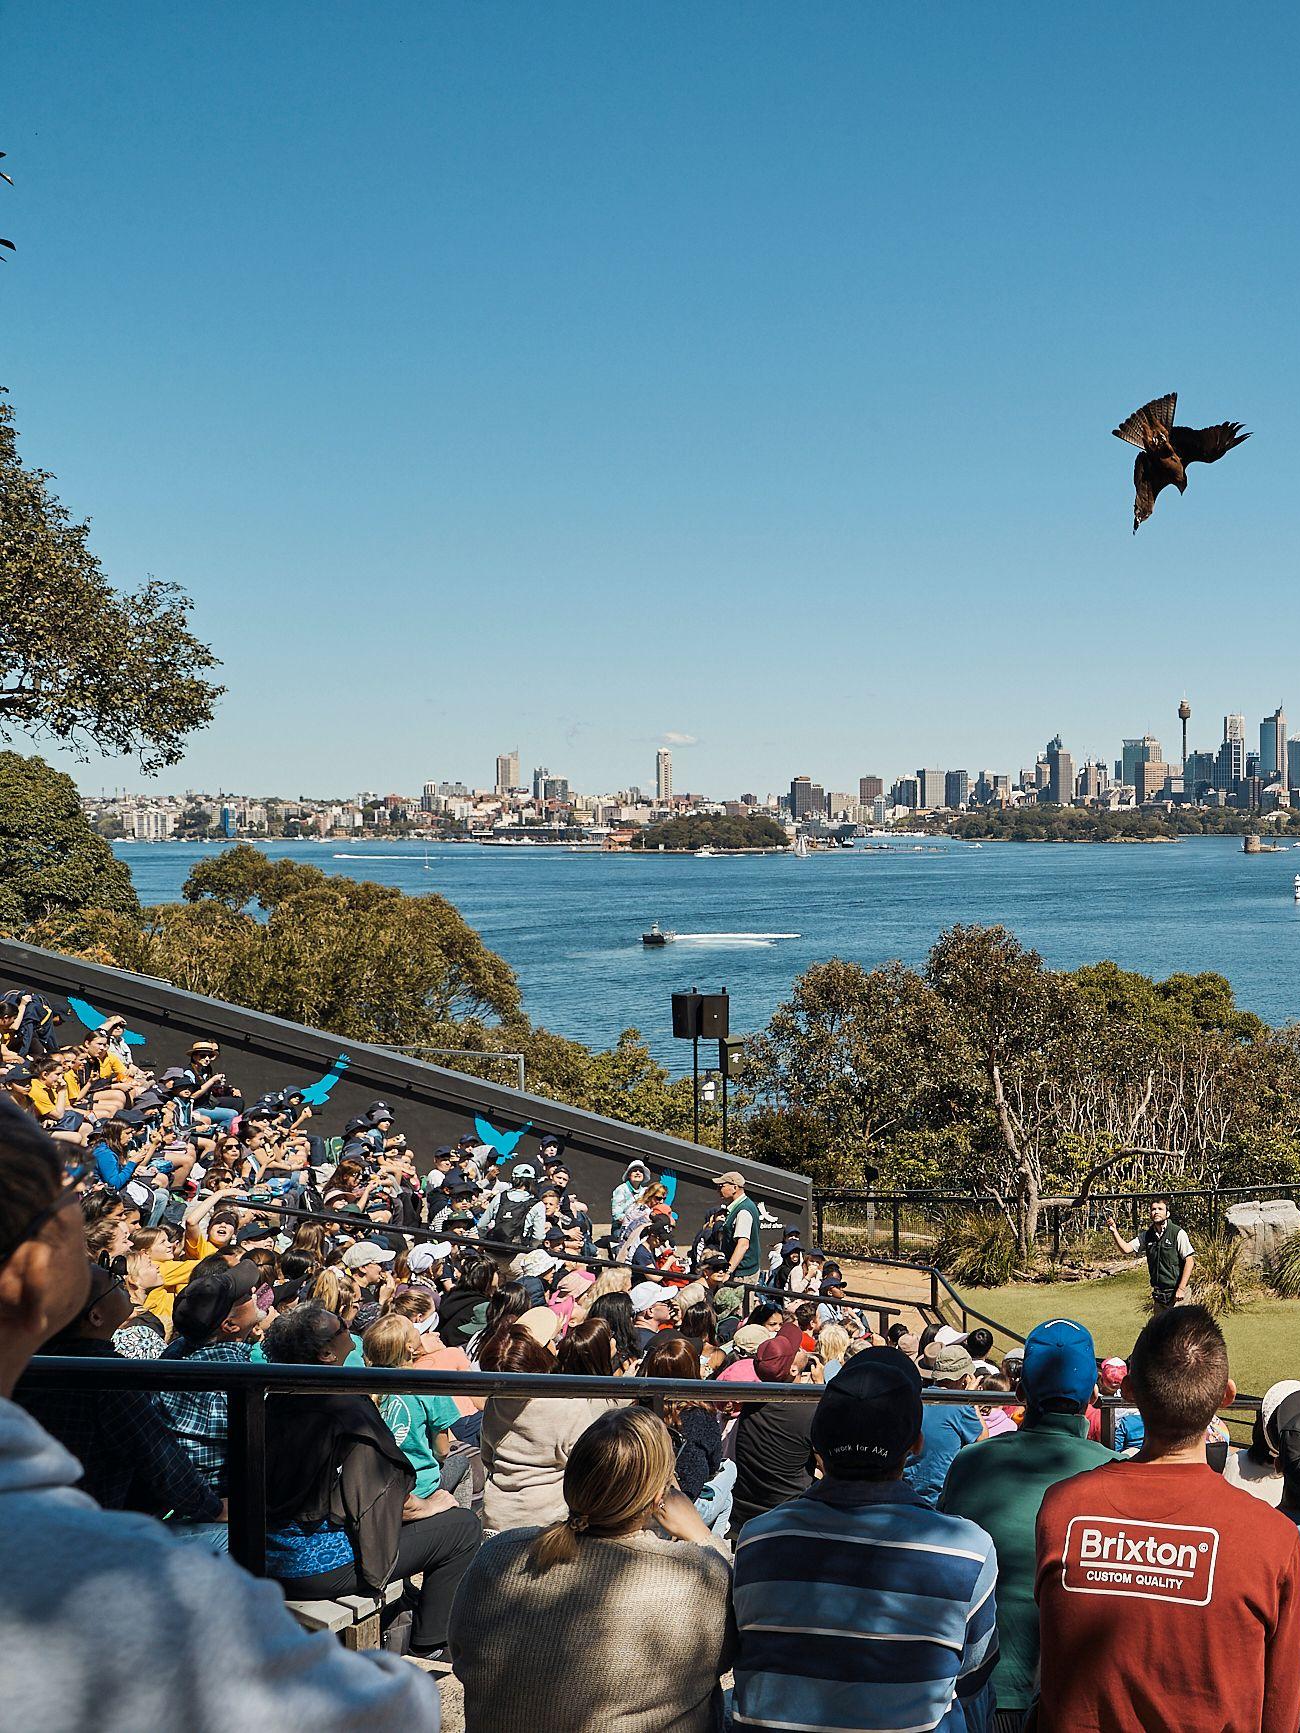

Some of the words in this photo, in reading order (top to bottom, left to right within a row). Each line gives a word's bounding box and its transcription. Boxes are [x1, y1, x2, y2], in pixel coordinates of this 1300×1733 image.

[834, 1444, 852, 1453] work
[856, 1444, 868, 1452] for
[872, 1446, 888, 1458] AXA
[1086, 1570, 1132, 1584] CUSTOM
[1136, 1574, 1183, 1590] QUALITY
